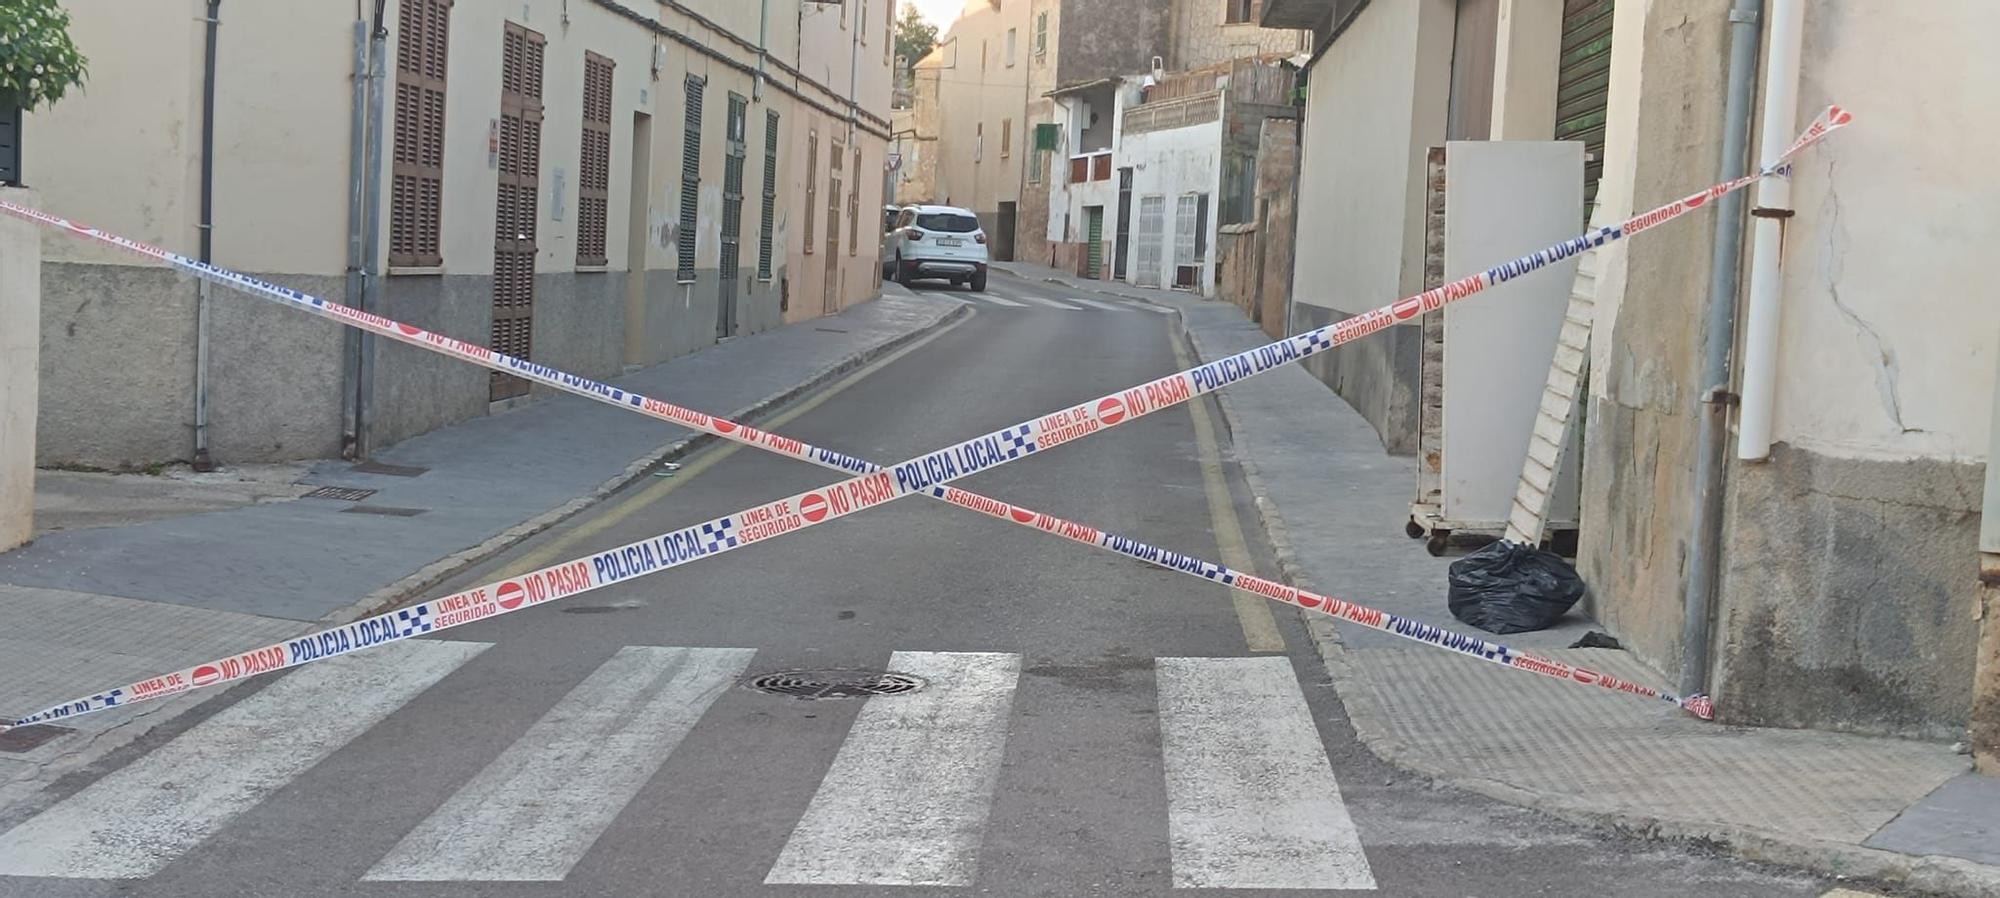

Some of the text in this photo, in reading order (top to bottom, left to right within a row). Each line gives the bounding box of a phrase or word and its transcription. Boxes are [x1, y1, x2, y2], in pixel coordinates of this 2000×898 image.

[1623, 203, 1682, 235] SEGURIDAD
[1421, 234, 1592, 311] NO PASAR POLICIA LOCAL
[1332, 314, 1393, 345] SEGURIDAD
[1124, 338, 1300, 417] NO PASAR POLICIA LOCAL
[644, 399, 708, 426] SEGURIDAD
[1039, 406, 1088, 433] LINEA DE
[1037, 420, 1098, 449] SEGURIDAD
[826, 436, 1007, 515] NO PASAR POLICIA LOCAL
[740, 501, 790, 528] LINEA DE
[946, 488, 1007, 516] SEGURIDAD
[738, 514, 801, 543] SEGURIDAD
[524, 530, 707, 604] NO PASAR POLICIA LOCAL
[437, 588, 487, 614] LINEA DE
[1235, 575, 1295, 602] SEGURIDAD
[434, 602, 496, 629] SEGURIDAD
[220, 612, 400, 680] NO PASAR POLICIA LOCAL
[131, 678, 165, 695] LINEA
[167, 673, 183, 687] DE
